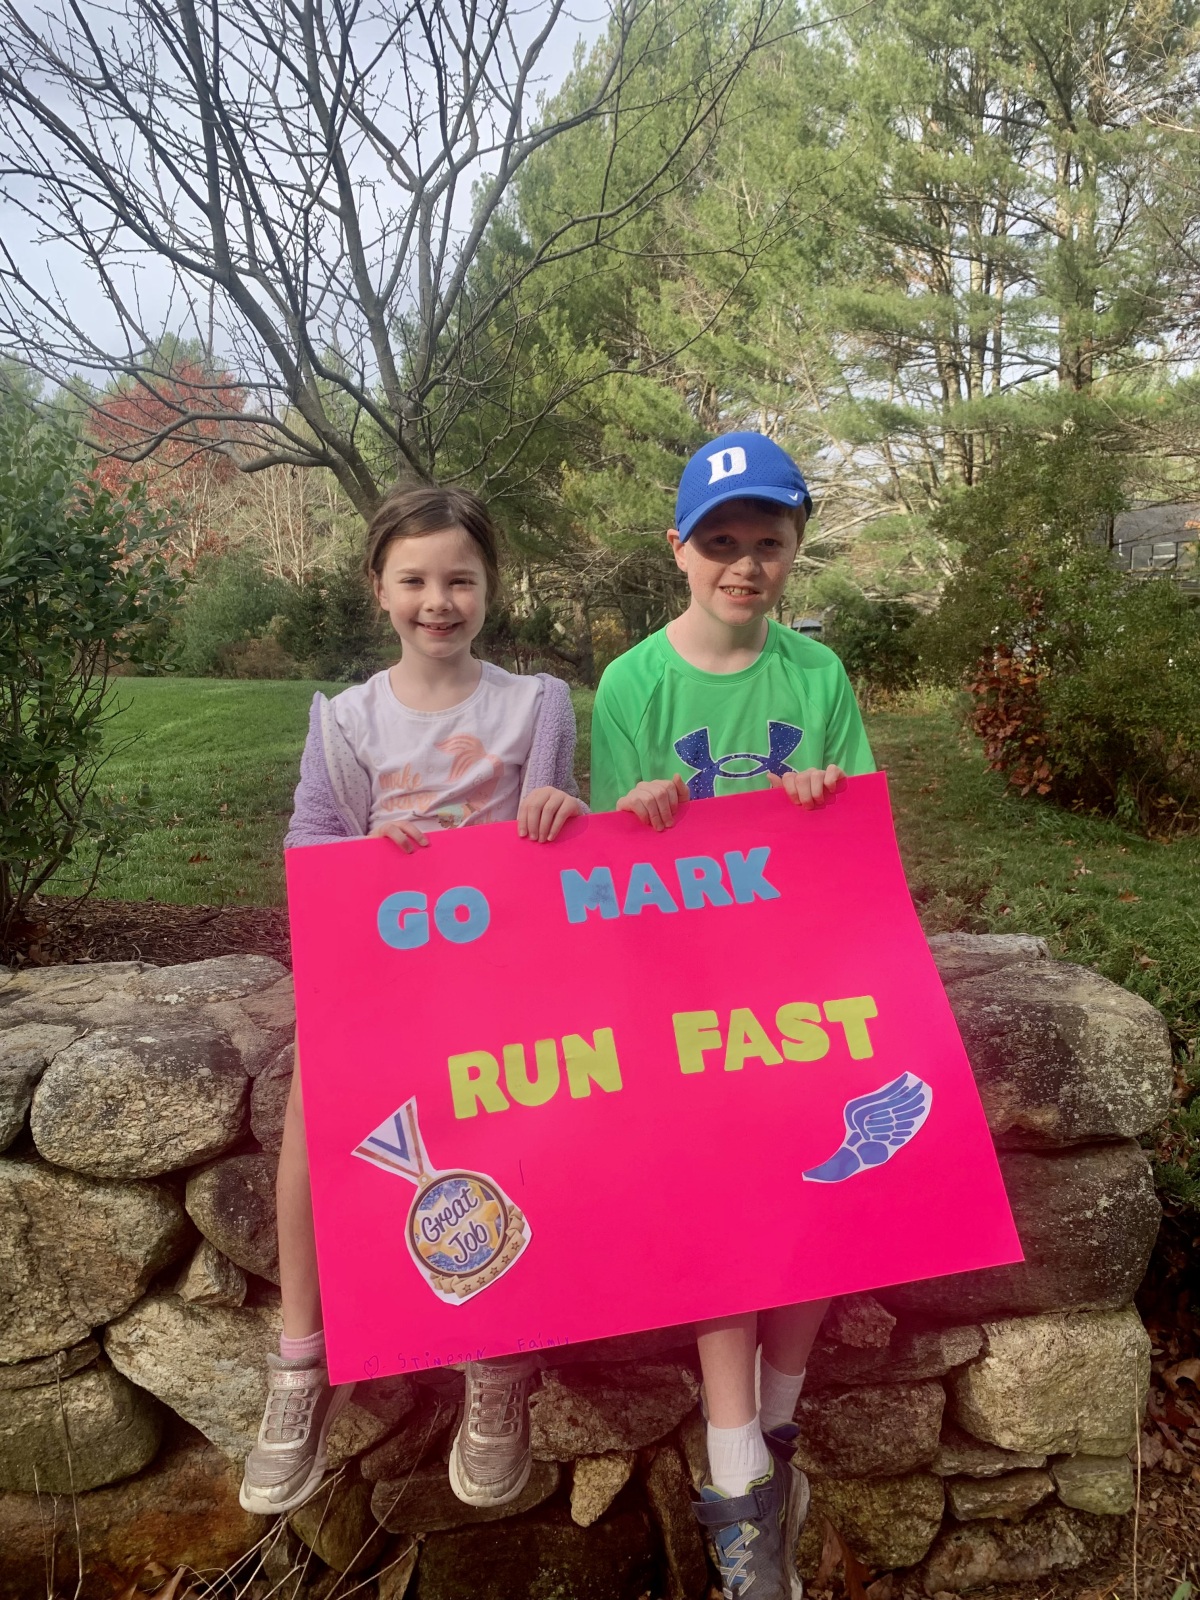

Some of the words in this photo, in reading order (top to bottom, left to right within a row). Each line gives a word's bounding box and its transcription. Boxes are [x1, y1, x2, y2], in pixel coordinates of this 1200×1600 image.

[706, 446, 747, 485] D
[377, 885, 491, 950] GO
[559, 846, 782, 924] MARK
[447, 1026, 623, 1120] RUN
[671, 995, 879, 1075] FAST
[420, 1187, 479, 1243] Great
[448, 1221, 488, 1264] Job
